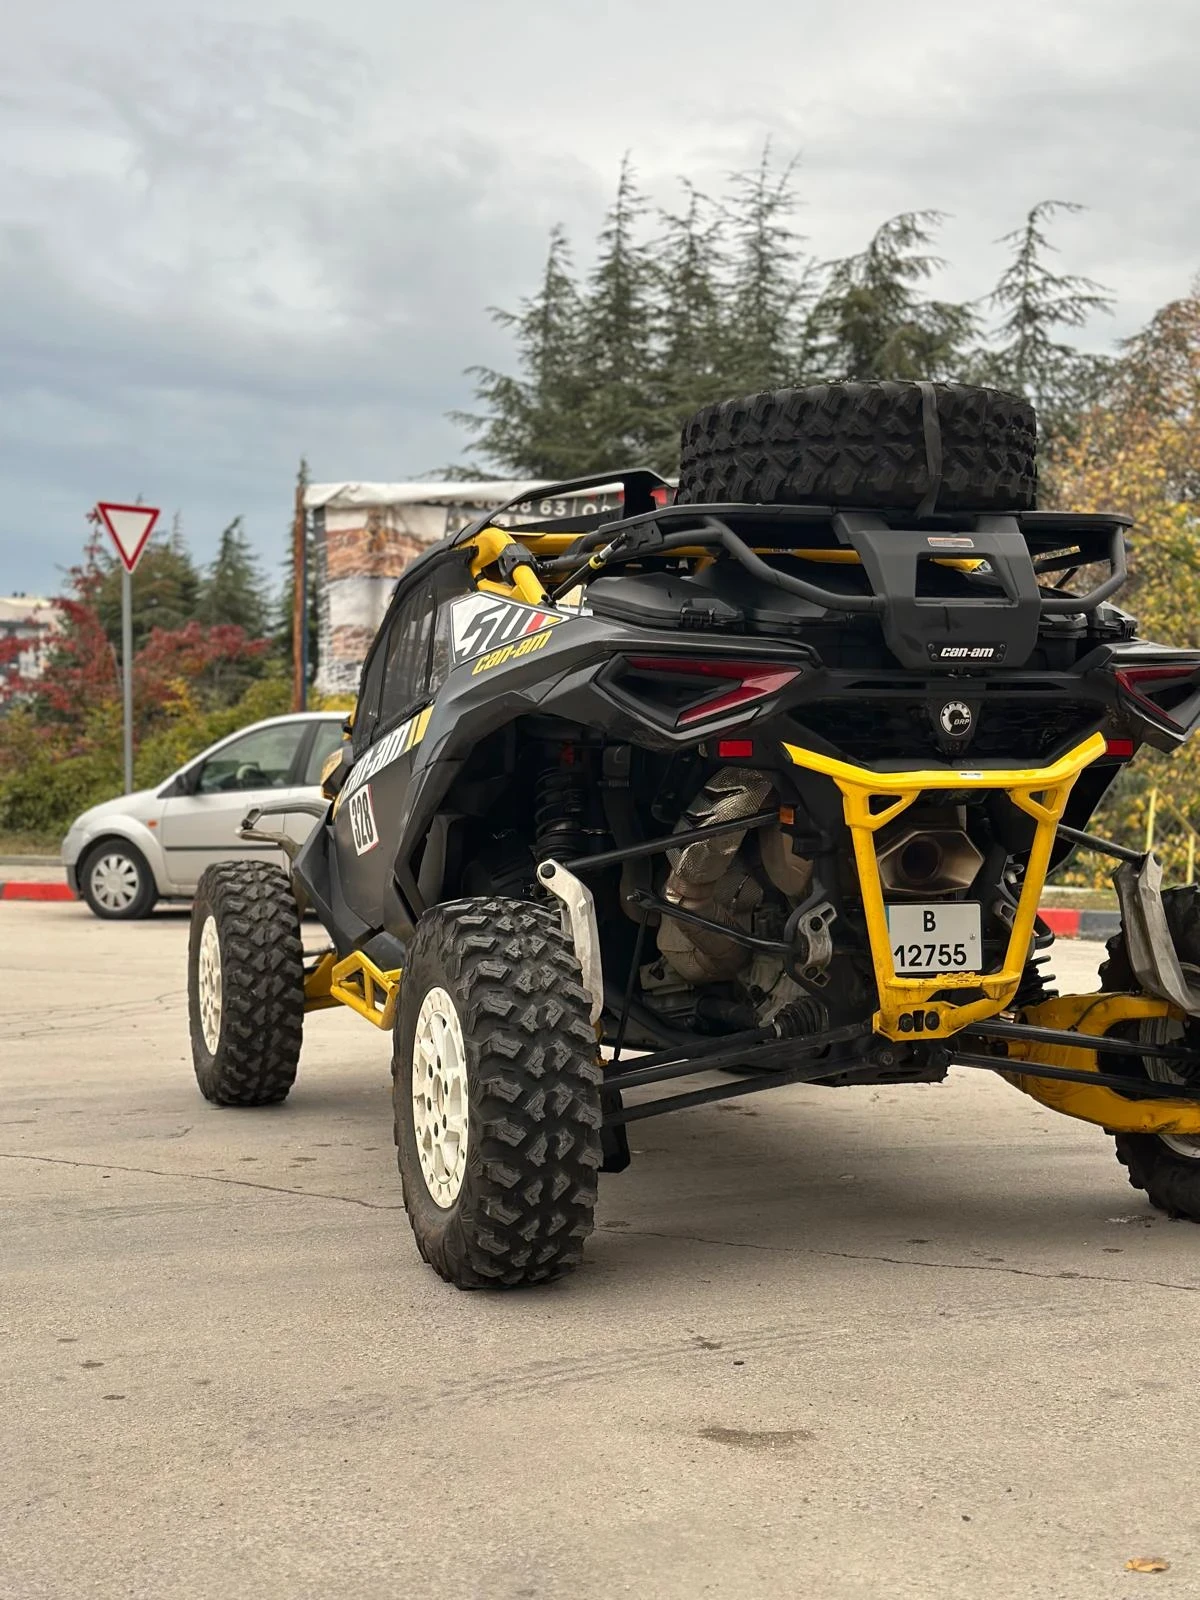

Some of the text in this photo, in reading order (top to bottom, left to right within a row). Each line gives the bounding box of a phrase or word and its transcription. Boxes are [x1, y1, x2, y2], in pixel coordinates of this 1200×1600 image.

[539, 500, 567, 516] 63
[471, 630, 553, 676] can-am
[940, 647, 994, 658] can-am
[351, 791, 374, 850] 328
[923, 910, 936, 932] B
[893, 943, 967, 967] 12755
